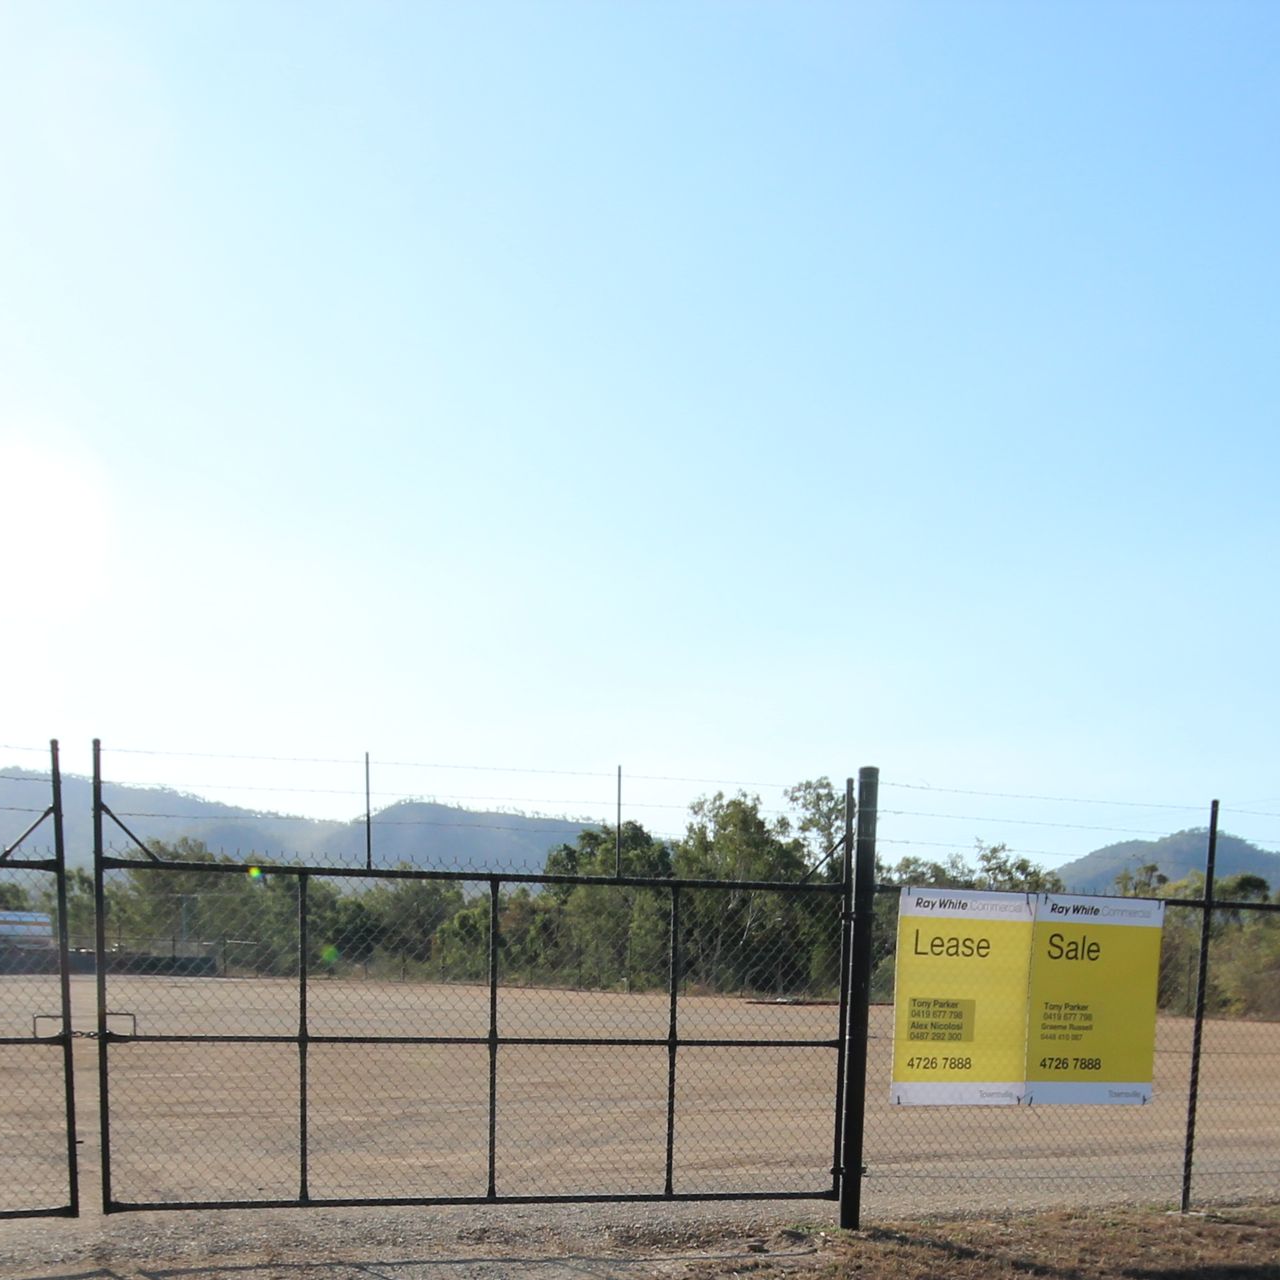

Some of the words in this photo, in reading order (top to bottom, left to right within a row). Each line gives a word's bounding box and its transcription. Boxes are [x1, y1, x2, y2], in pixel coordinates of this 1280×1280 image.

[915, 897, 937, 911] Ray
[939, 898, 968, 910] White
[1050, 903, 1073, 916] Ray
[1072, 904, 1100, 916] White
[914, 928, 991, 958] Lease
[1047, 932, 1101, 961] Sale
[911, 998, 931, 1009] Tony
[933, 999, 959, 1009] Parker
[1044, 1002, 1062, 1012] Tony
[1064, 1003, 1089, 1012] Parker
[910, 1021, 928, 1030] Alex
[907, 1057, 938, 1070] 4726
[942, 1057, 972, 1070] 7888
[1040, 1057, 1069, 1070] 4726
[1072, 1057, 1102, 1070] 7888
